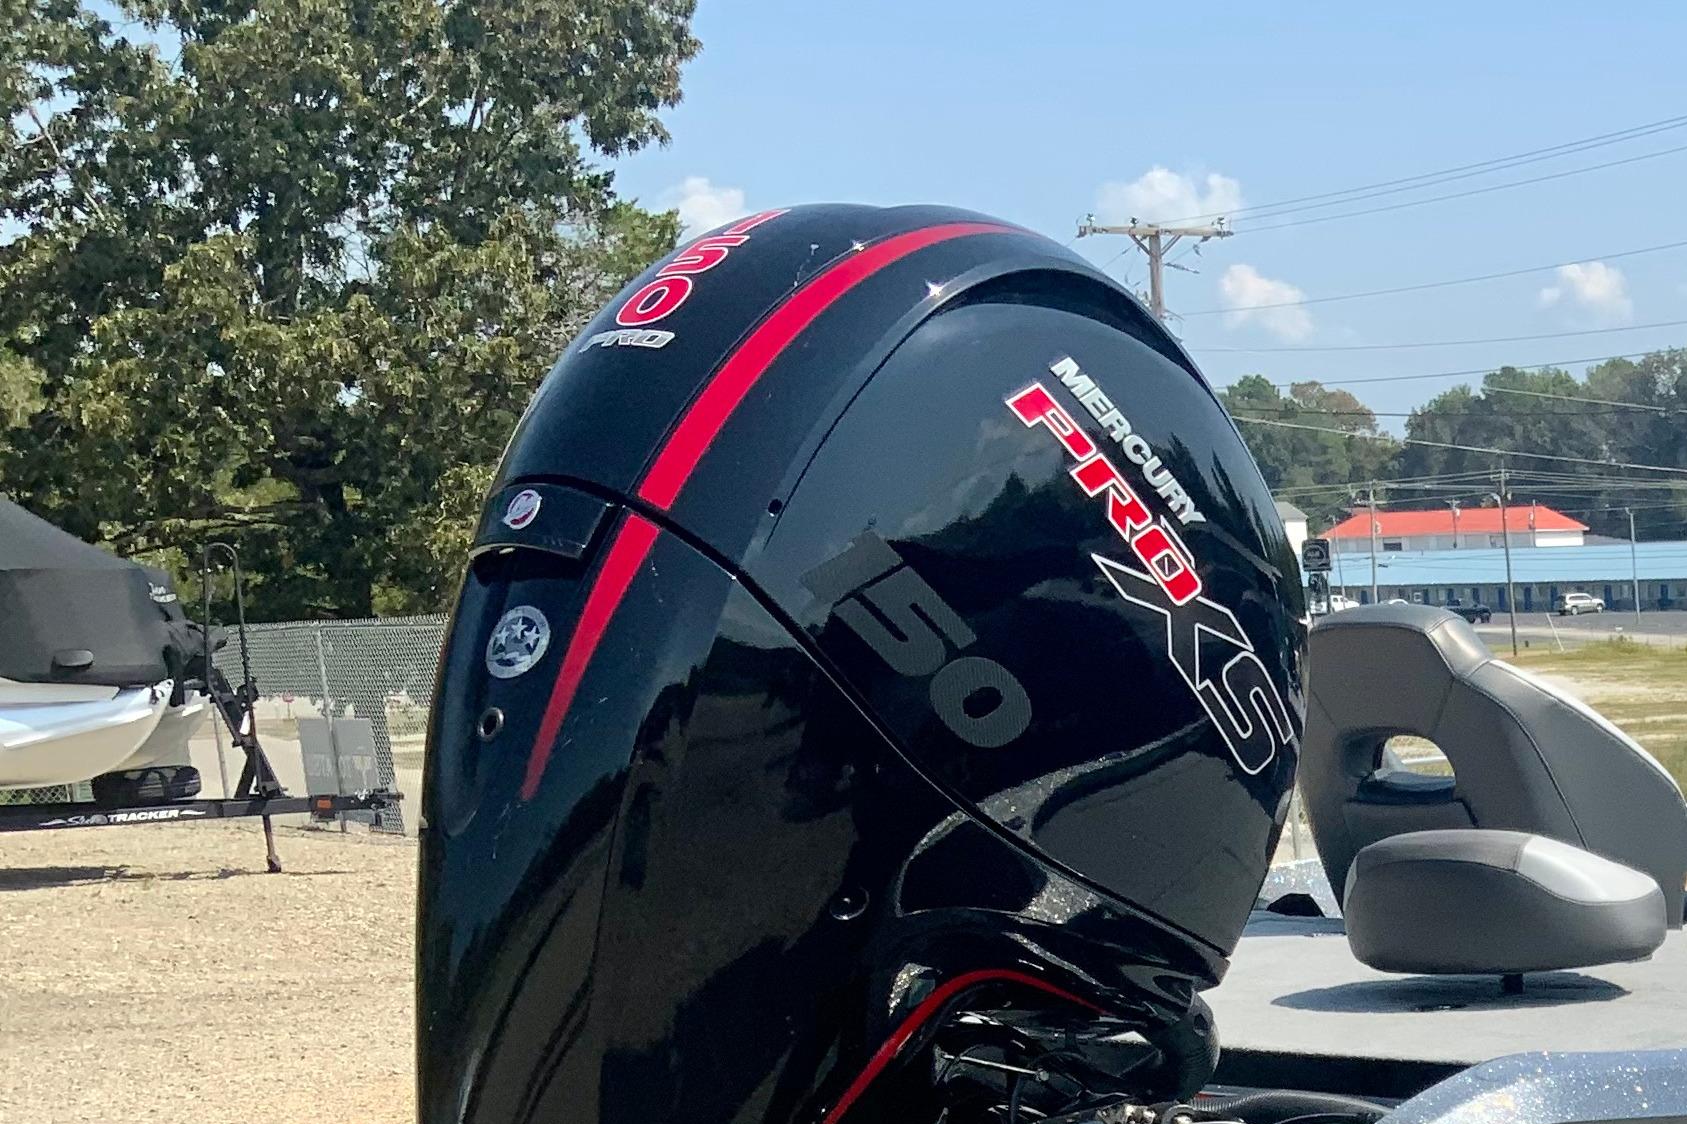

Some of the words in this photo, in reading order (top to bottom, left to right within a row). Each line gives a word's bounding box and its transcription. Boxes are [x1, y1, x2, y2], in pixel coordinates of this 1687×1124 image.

[578, 329, 675, 353] PRO
[616, 208, 792, 326] 150
[1005, 382, 1202, 606] PRO
[1050, 356, 1206, 526] MERCURY
[801, 531, 1032, 748] 150
[1091, 515, 1294, 775] XS
[108, 810, 180, 823] TRACKER
